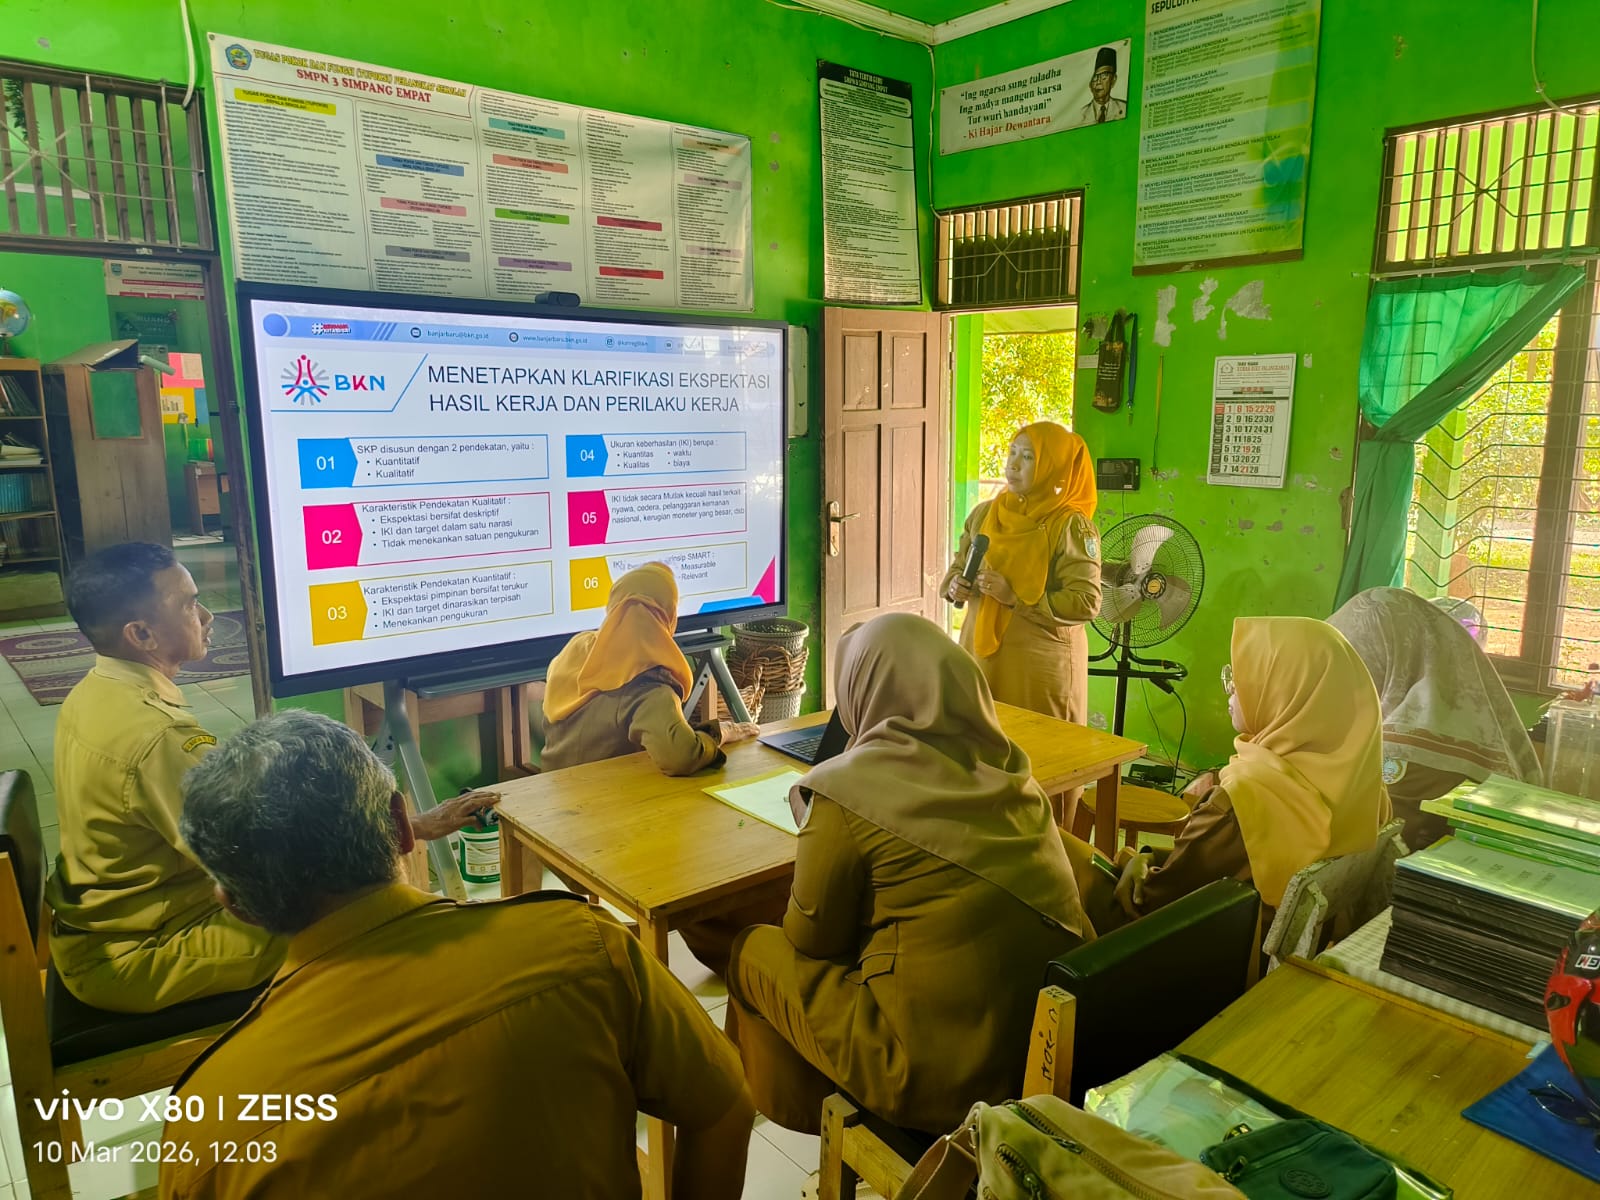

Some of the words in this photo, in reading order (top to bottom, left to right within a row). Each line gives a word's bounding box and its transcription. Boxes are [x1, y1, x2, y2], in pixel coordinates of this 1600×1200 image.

[296, 69, 329, 84] SMPN
[332, 77, 339, 87] 3
[341, 77, 393, 96] SIMPANG
[396, 87, 432, 103] EMPAT
[979, 84, 1005, 98] ngarsa
[1008, 78, 1027, 90] sung
[1030, 68, 1061, 84] tuladha
[960, 104, 973, 115] Ing
[975, 98, 999, 112] madya
[1002, 89, 1035, 104] mangun
[1037, 83, 1062, 95] karsa
[967, 115, 981, 125] Tut
[983, 111, 1002, 122] wuri
[968, 130, 977, 139] Ki
[980, 125, 1002, 138] Hajar
[1005, 115, 1051, 132] Dewantara
[334, 374, 385, 391] BKN
[428, 365, 566, 386] MENETAPKAN
[572, 369, 674, 388] KLARIFIKASI
[680, 371, 770, 389] EKSPEKTASI
[430, 394, 490, 412] HASIL
[496, 395, 558, 412] KERJA
[563, 395, 600, 412] DAN
[606, 396, 686, 412] PERILAKU
[691, 397, 739, 413] KERJA
[1226, 425, 1231, 433] 3
[1234, 425, 1242, 433] 10
[610, 440, 635, 449] Ukuran
[636, 439, 677, 448] keberhasilan
[679, 439, 692, 448] (IKI)
[693, 439, 714, 448] berupa
[1225, 435, 1230, 443] 4
[357, 445, 377, 454] SKP
[380, 444, 414, 454] disusun
[418, 444, 449, 455] dengan
[452, 443, 457, 452] 2
[460, 442, 509, 455] pendekatan,
[511, 442, 529, 452] yaitu
[580, 449, 595, 461] 04
[623, 450, 654, 458] Kuantitas
[673, 449, 692, 457] waktu
[316, 456, 335, 471] 01
[375, 457, 420, 466] Kuantitatif
[623, 461, 650, 469] Kualitas
[673, 459, 690, 468] biaya
[376, 469, 414, 478] Kualitatif
[1231, 465, 1239, 473] 14
[362, 502, 417, 513] Karakteristik
[420, 499, 469, 510] Pendekatan
[472, 497, 507, 507] Kualitatif
[612, 495, 620, 503] IKI
[622, 494, 638, 502] tidak
[663, 502, 700, 511] pelanggaran
[380, 513, 428, 525] Ekspektasi
[430, 511, 461, 520] bersifat
[463, 509, 499, 520] deskriptif
[582, 512, 597, 524] 05
[643, 513, 670, 522] kerugian
[699, 511, 713, 519] yang
[381, 527, 393, 536] IKI
[396, 526, 412, 536] dan
[415, 524, 439, 536] target
[442, 522, 467, 532] dalam
[469, 522, 486, 530] satu
[488, 519, 513, 528] narasi
[322, 530, 342, 545] 02
[382, 538, 405, 548] Tidak
[408, 535, 462, 546] menekankan
[464, 532, 491, 542] satuan
[493, 528, 539, 541] pengukuran
[688, 552, 710, 560] SMART
[681, 561, 716, 570] Measurable
[363, 583, 418, 596] Karakteristik
[421, 578, 469, 590] Pendekatan
[472, 573, 511, 584] Kuantitatif
[583, 577, 599, 590] 06
[381, 593, 428, 607] Ekspektasi
[431, 588, 468, 601] pimpinan
[470, 585, 500, 595] bersifat
[501, 581, 529, 591] terukur
[382, 608, 395, 618] IKI
[397, 606, 413, 616] dan
[416, 603, 441, 617] target
[442, 597, 489, 610] dinarasikan
[490, 593, 521, 605] terpisah
[327, 606, 348, 621] 03
[383, 615, 438, 629] Menekankan
[440, 609, 488, 622] pengukuran
